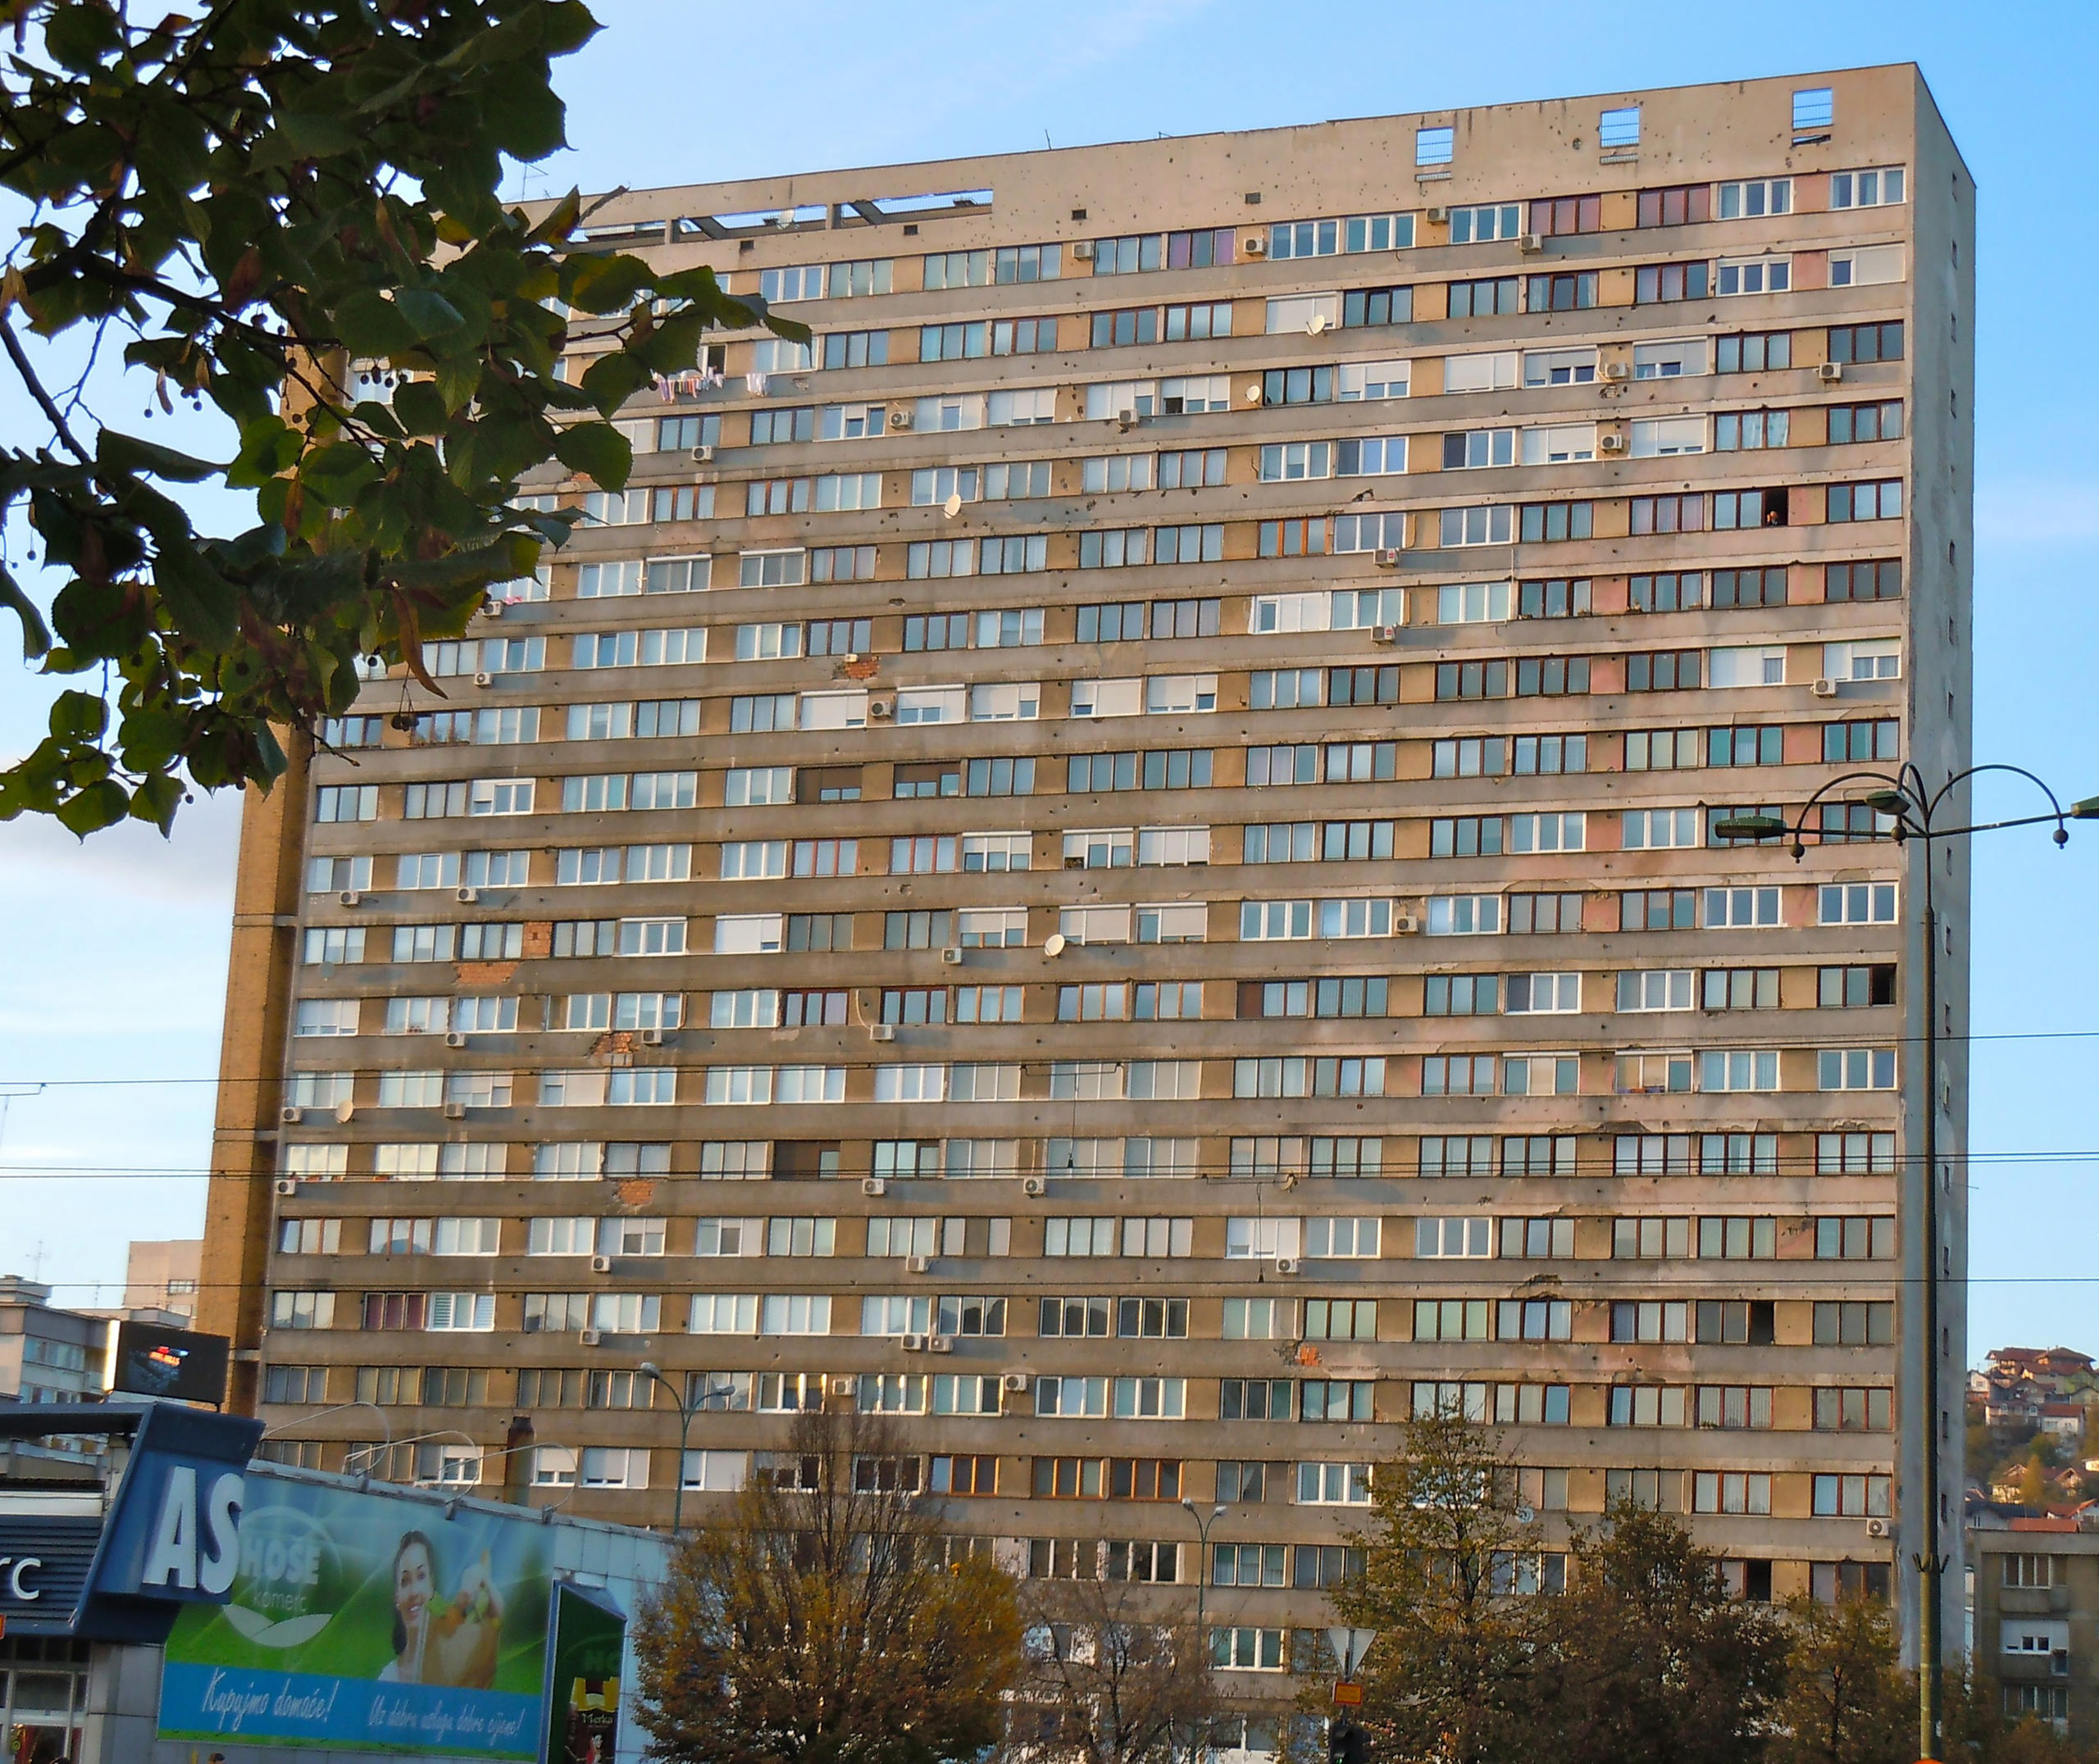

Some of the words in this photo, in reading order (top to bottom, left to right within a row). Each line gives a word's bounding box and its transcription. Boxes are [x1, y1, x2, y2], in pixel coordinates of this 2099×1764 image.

[143, 1466, 245, 1594] AS
[253, 1589, 307, 1612] komerc
[203, 1667, 269, 1731] Kupujmo
[274, 1678, 339, 1723] domaće!
